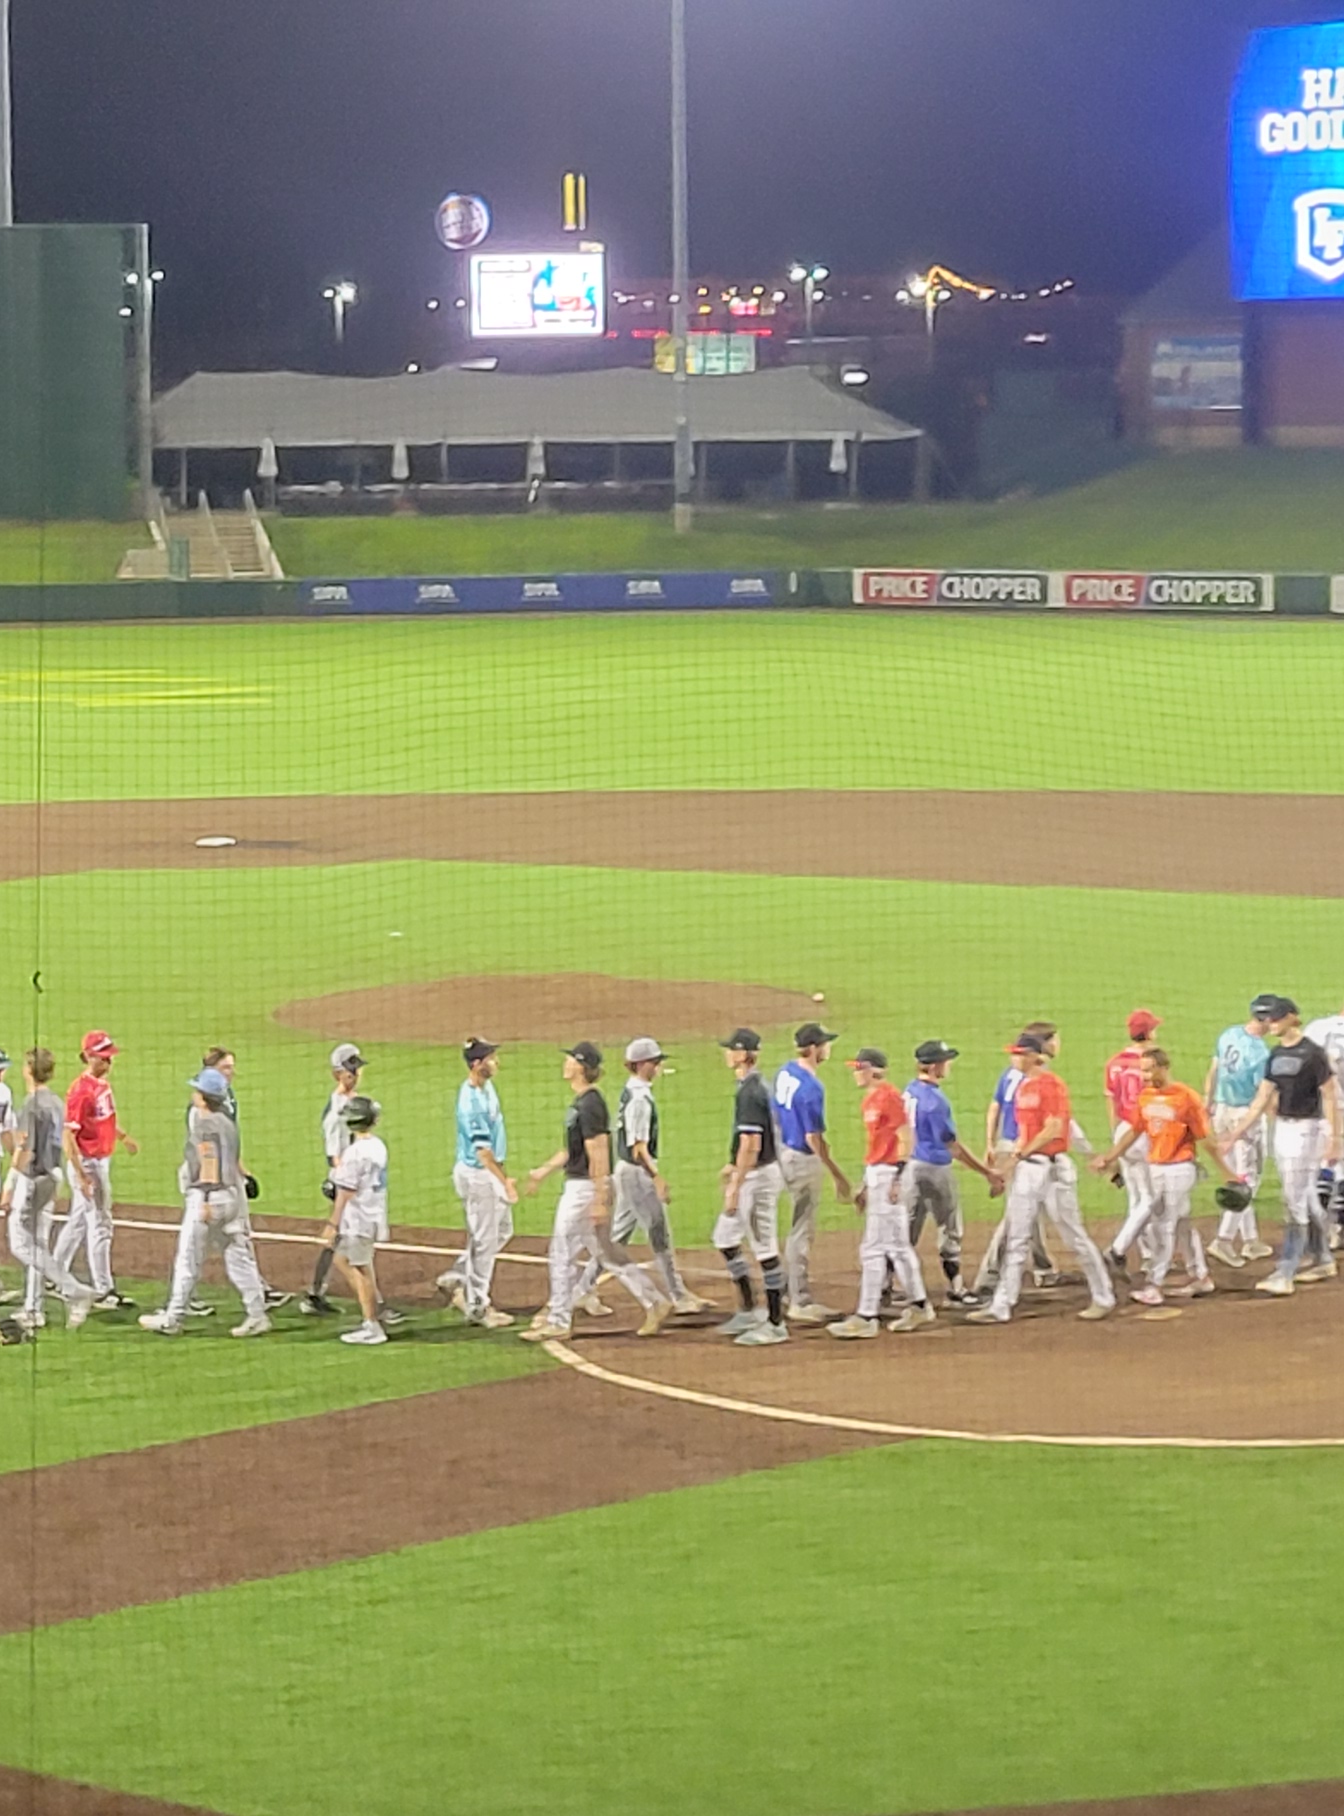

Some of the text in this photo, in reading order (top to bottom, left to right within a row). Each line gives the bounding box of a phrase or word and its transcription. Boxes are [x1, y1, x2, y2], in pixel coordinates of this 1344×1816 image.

[868, 576, 1042, 601] PRICE CHOPPER
[1071, 579, 1255, 604] PRICE CHOPPER
